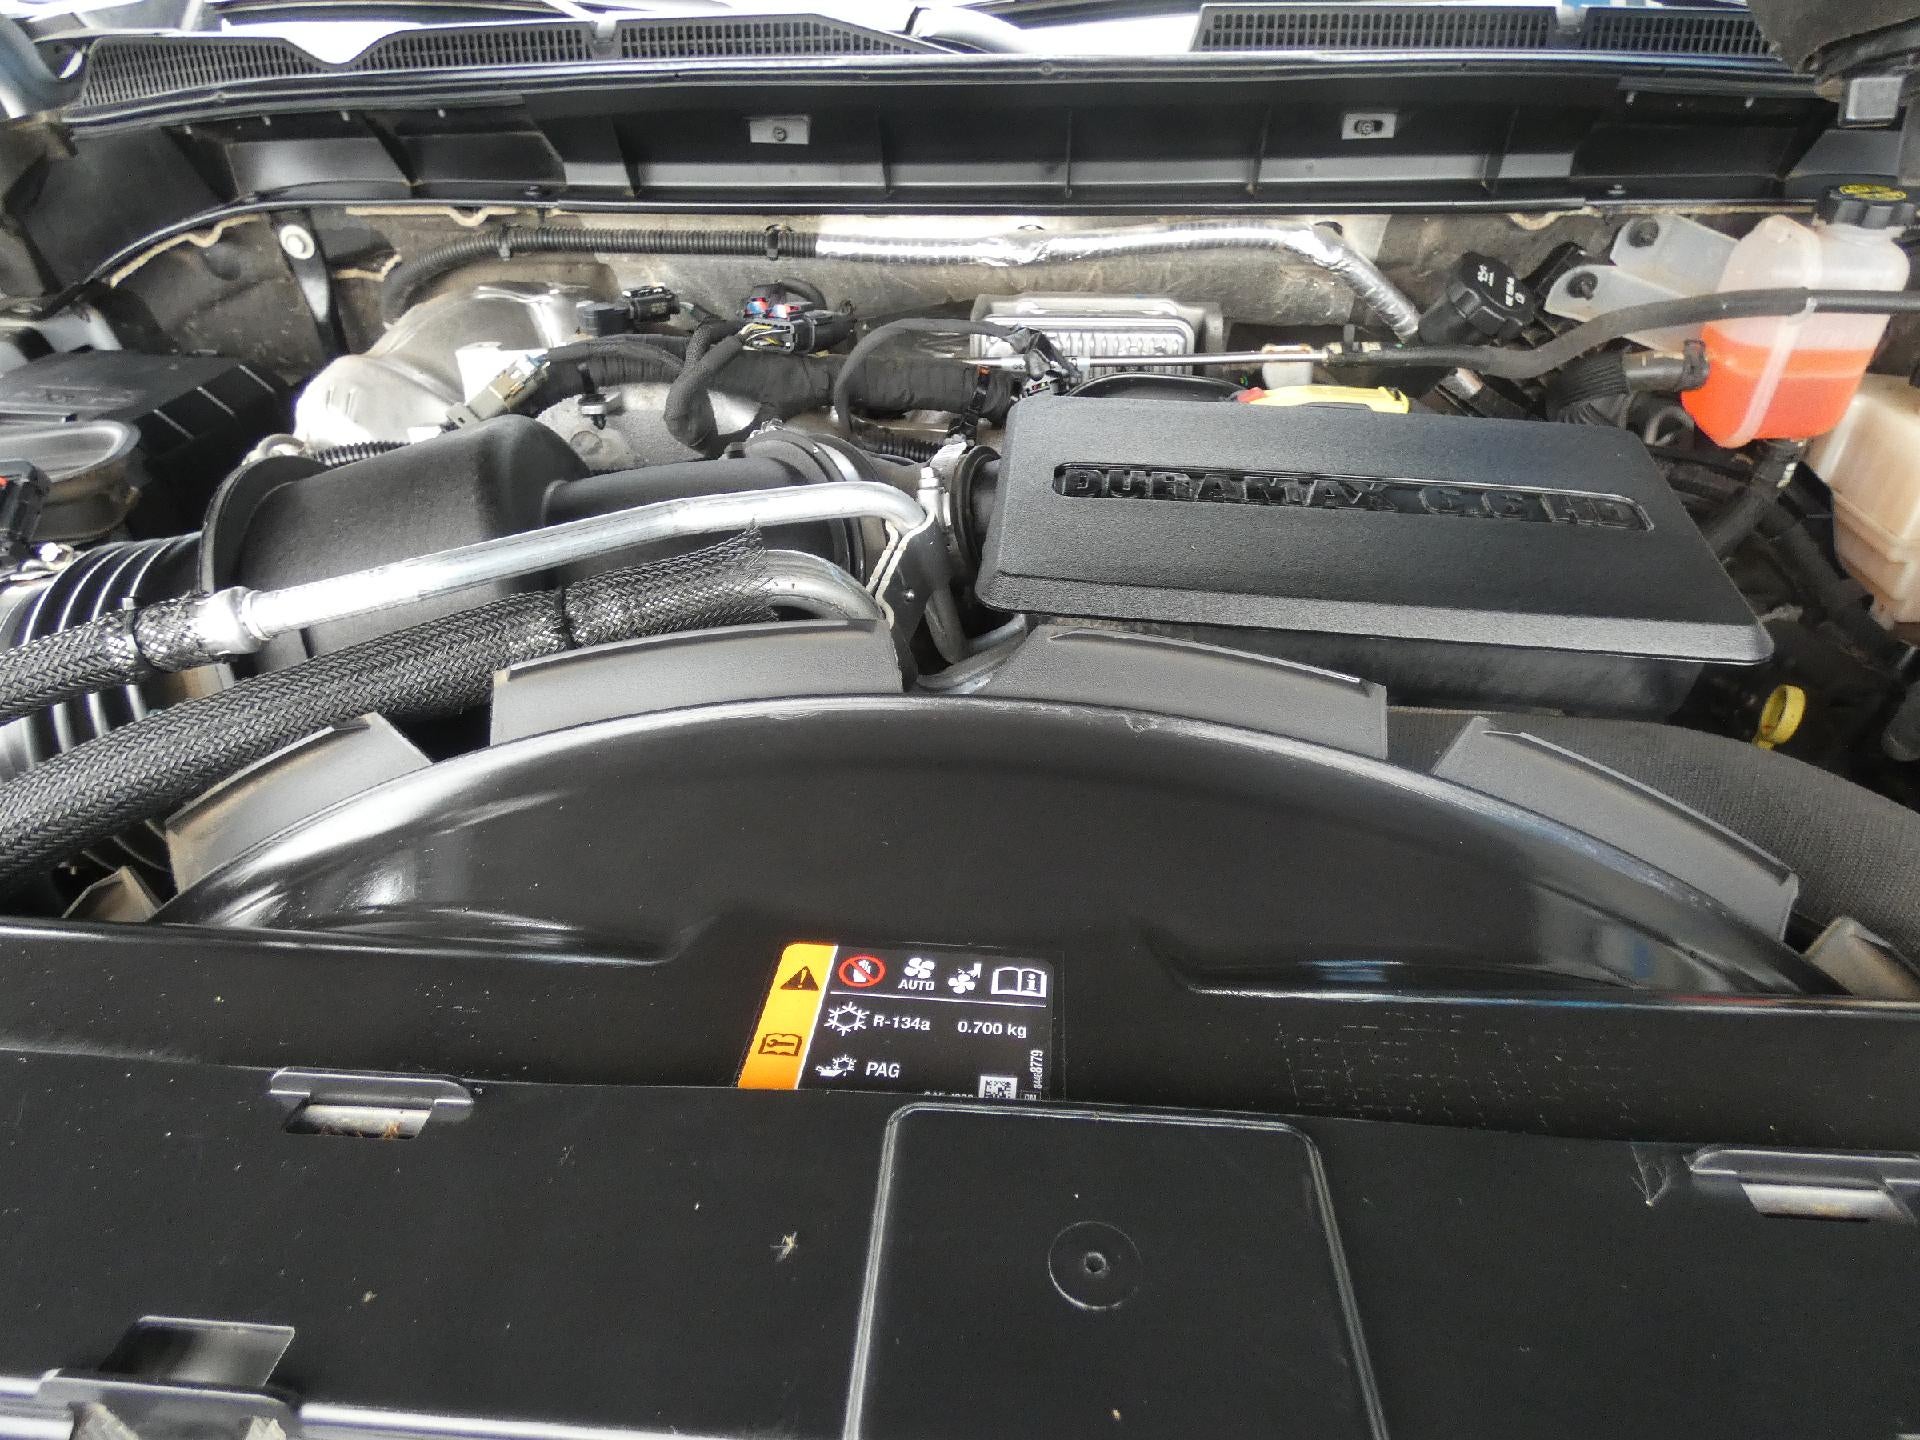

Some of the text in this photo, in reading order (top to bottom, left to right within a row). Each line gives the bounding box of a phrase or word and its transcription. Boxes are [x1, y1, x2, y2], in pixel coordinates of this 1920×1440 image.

[1062, 468, 1399, 512] DURAMAX
[898, 979, 935, 991] AUTO
[873, 1014, 1027, 1039] R-134a 0.700 kg
[865, 1061, 901, 1079] PAG
